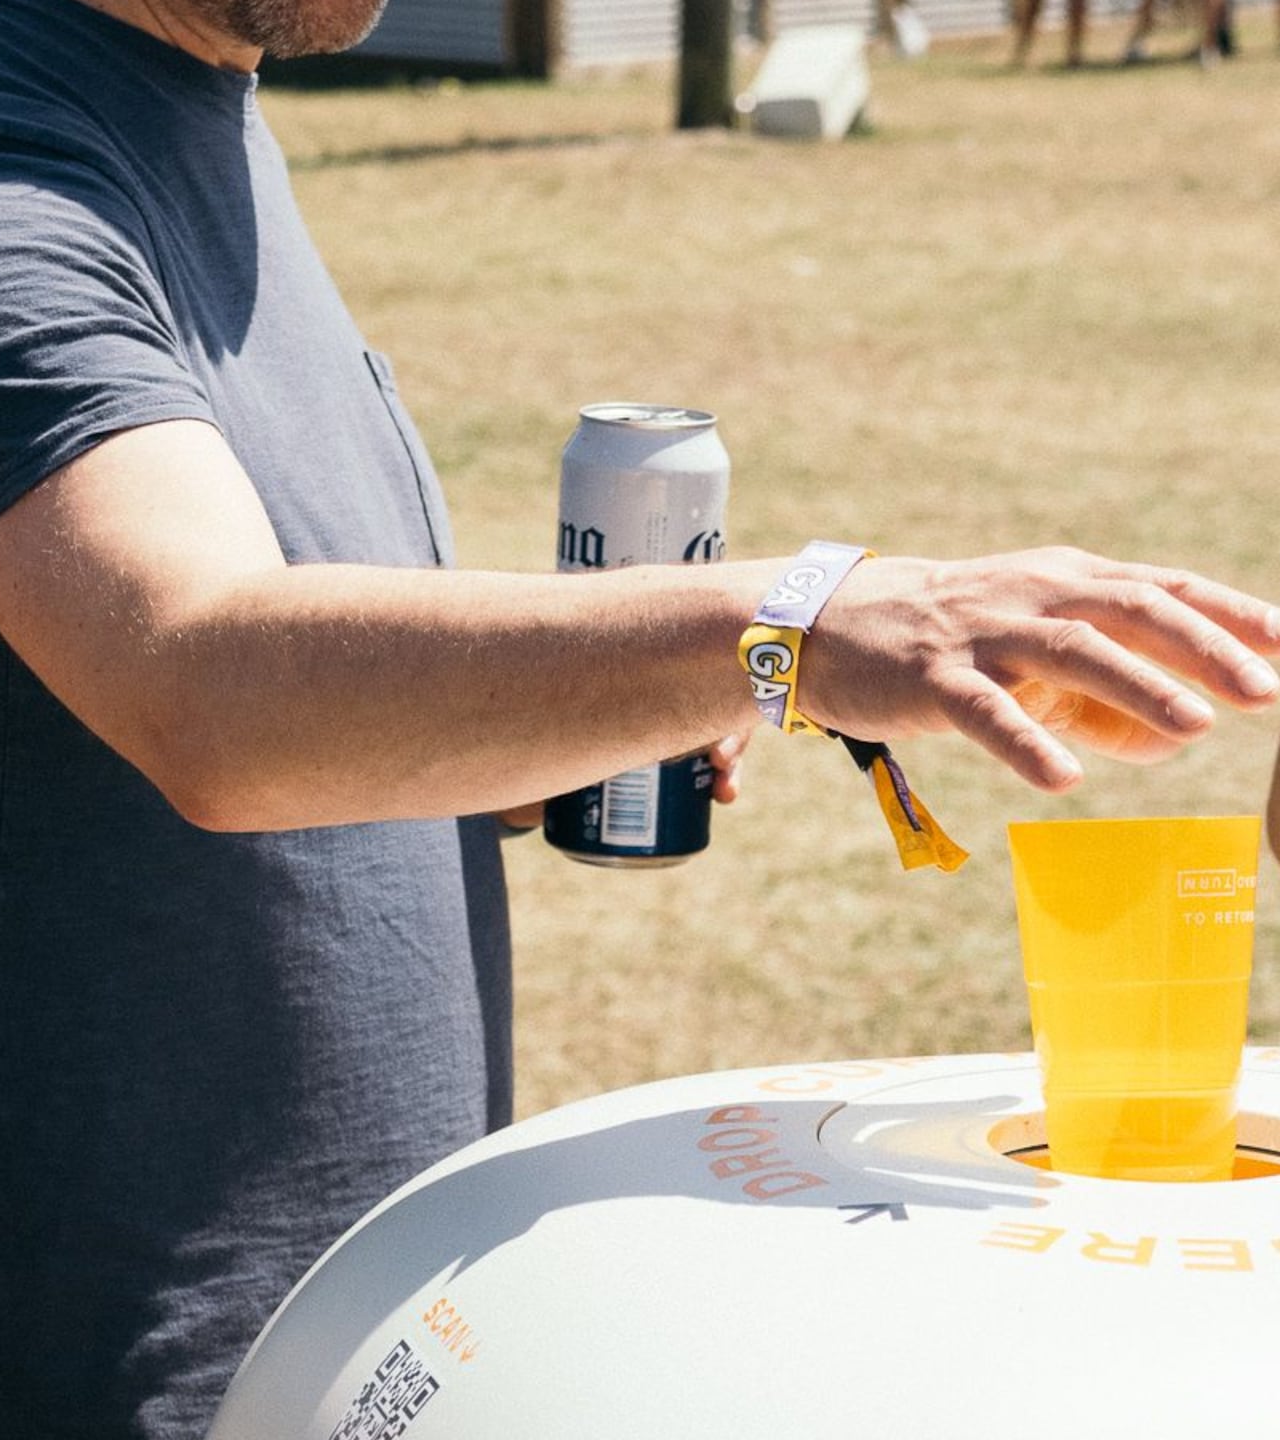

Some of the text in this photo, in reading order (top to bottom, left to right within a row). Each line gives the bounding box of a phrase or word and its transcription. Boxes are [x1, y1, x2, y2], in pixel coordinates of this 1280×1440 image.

[764, 565, 826, 608] GA
[748, 642, 794, 701] GA
[1183, 912, 1205, 927] TO
[696, 1104, 830, 1201] DROP
[423, 1298, 472, 1352] SCAN
